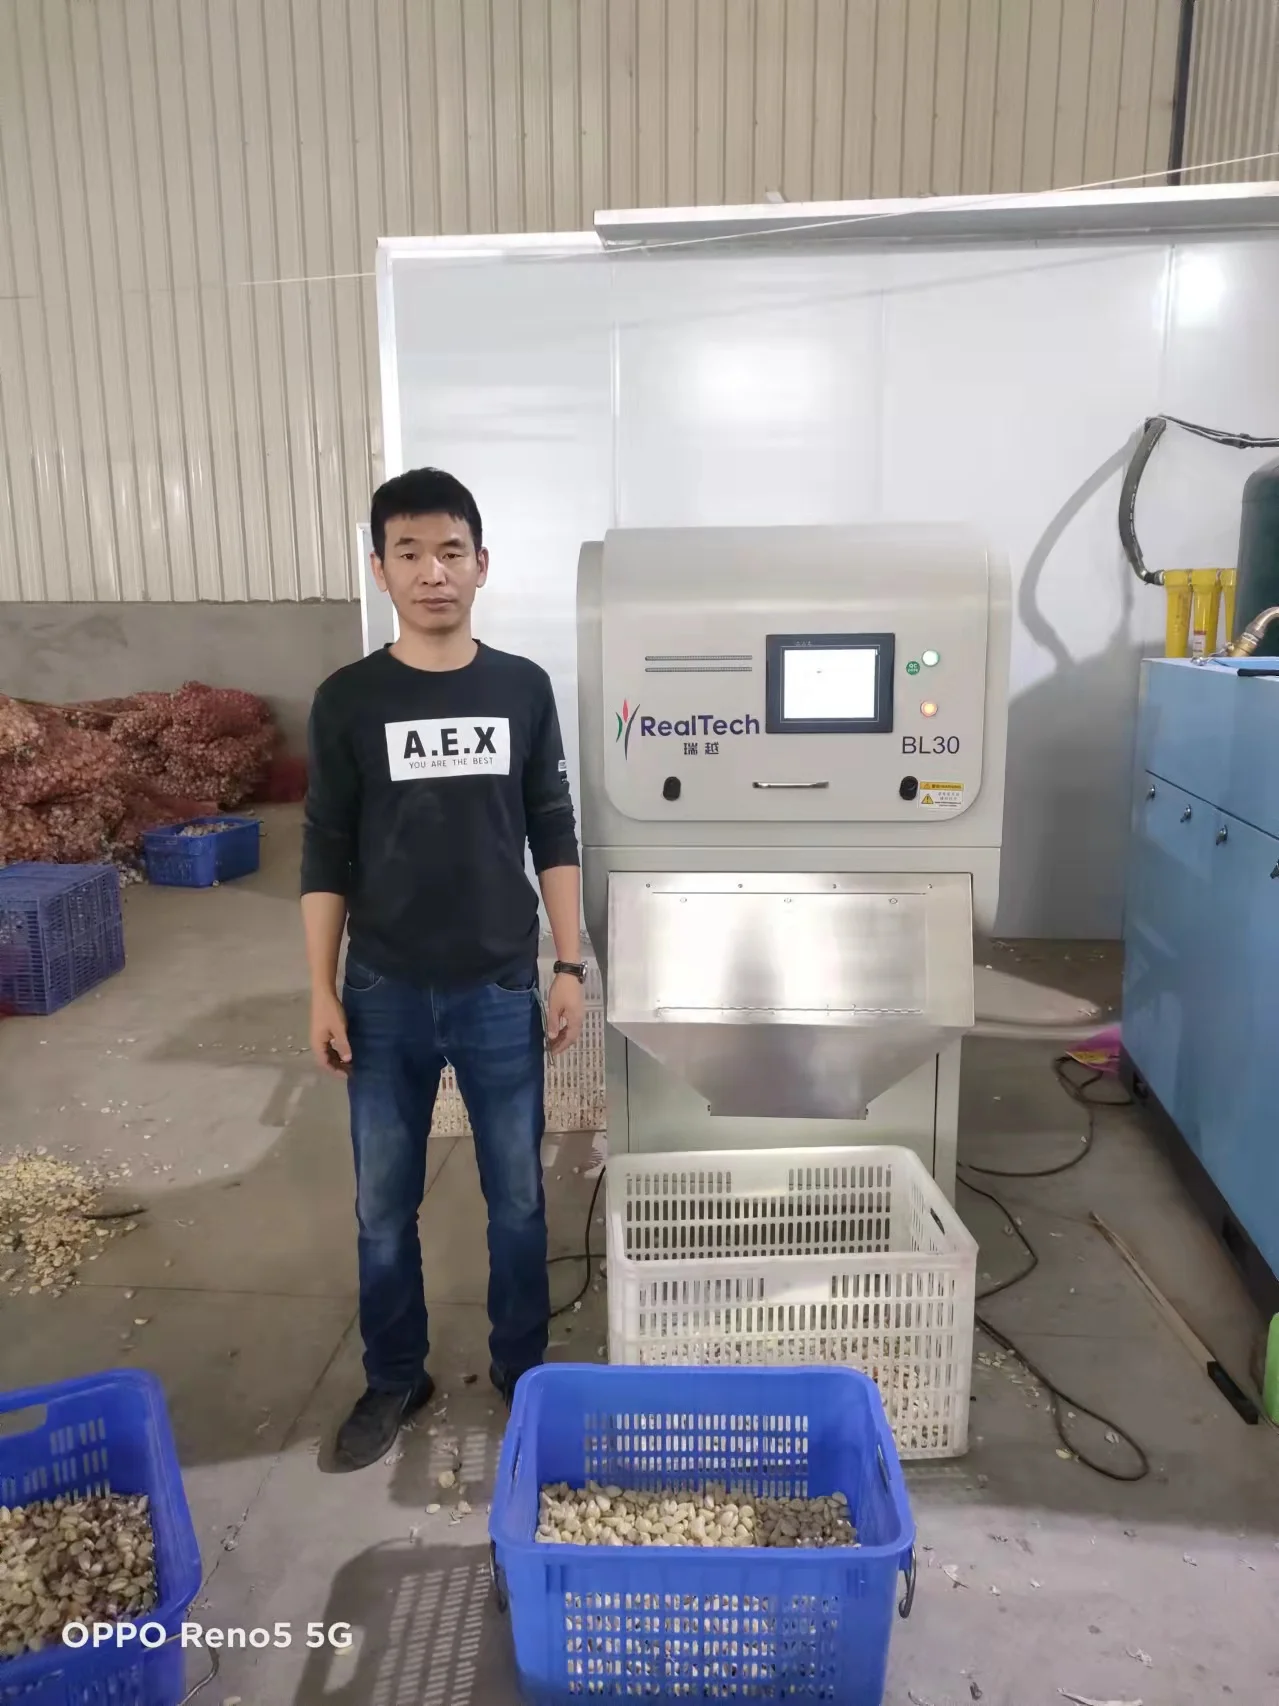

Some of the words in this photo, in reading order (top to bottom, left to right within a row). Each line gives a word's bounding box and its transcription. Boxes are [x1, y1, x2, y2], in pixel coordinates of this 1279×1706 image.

[640, 714, 760, 737] RealTech
[403, 726, 497, 759] A.E.X
[683, 741, 719, 755] 瑞越
[902, 735, 960, 754] BL30
[409, 761, 426, 769] YOU
[431, 760, 447, 768] ARE
[472, 757, 493, 765] BEST
